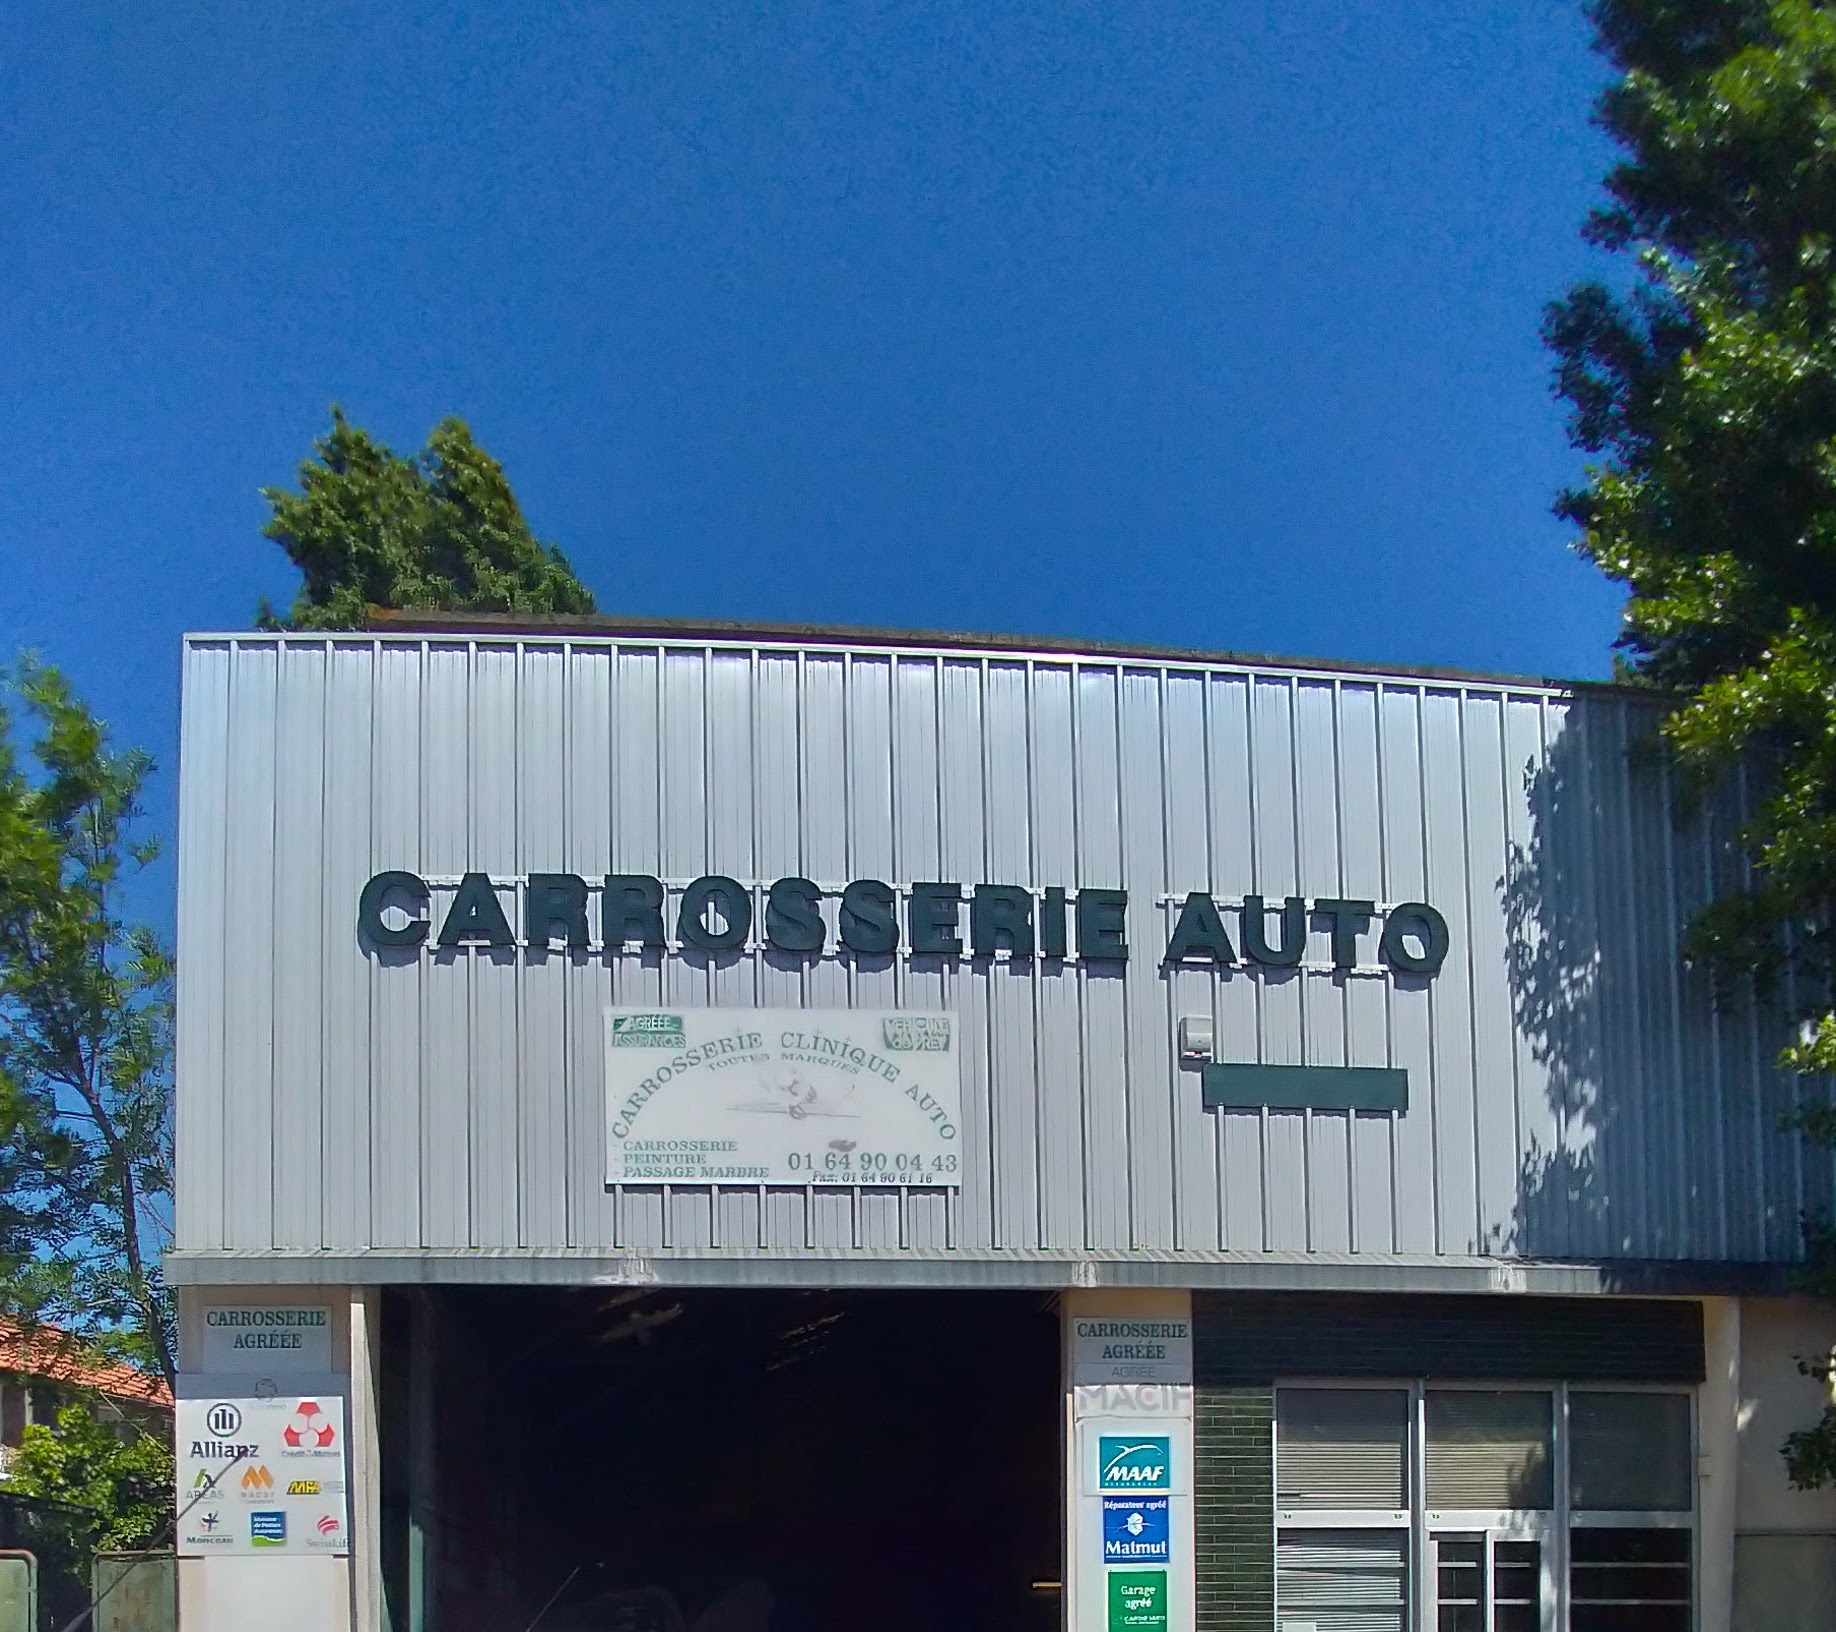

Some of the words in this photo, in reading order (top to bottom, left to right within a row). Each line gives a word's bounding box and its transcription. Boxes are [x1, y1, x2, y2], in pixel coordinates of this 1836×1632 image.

[359, 870, 1129, 961] CARROSSERIE
[1162, 891, 1450, 974] AUTO
[707, 1053, 770, 1072] TOUTES
[781, 1053, 861, 1074] MARQUES
[612, 1032, 764, 1139] CARROSSERIE
[781, 1031, 900, 1083] CLINIQUE
[904, 1084, 957, 1140] AUTO
[623, 1140, 738, 1152] CARROSSERIE
[623, 1154, 707, 1164] PEINTURE
[788, 1152, 813, 1171] 01
[825, 1152, 852, 1171] 64
[860, 1152, 888, 1171] 90
[896, 1153, 923, 1172] 04
[931, 1154, 957, 1173] 43
[623, 1166, 696, 1178] PASSAGE
[700, 1166, 770, 1178] MARBRE
[842, 1172, 857, 1182] 01
[207, 1310, 326, 1327] CARROSSERIE
[233, 1329, 303, 1349] AGRÉÉE
[1077, 1323, 1188, 1339] CARROSSERIE
[1102, 1340, 1166, 1359] AGRÉÉE
[1080, 1384, 1192, 1412] MACIF
[190, 1441, 259, 1459] Allianz
[1105, 1465, 1164, 1481] MAAF
[1105, 1540, 1167, 1555] Matmut
[1120, 1585, 1156, 1597] Garage
[1124, 1597, 1152, 1610] agréé
